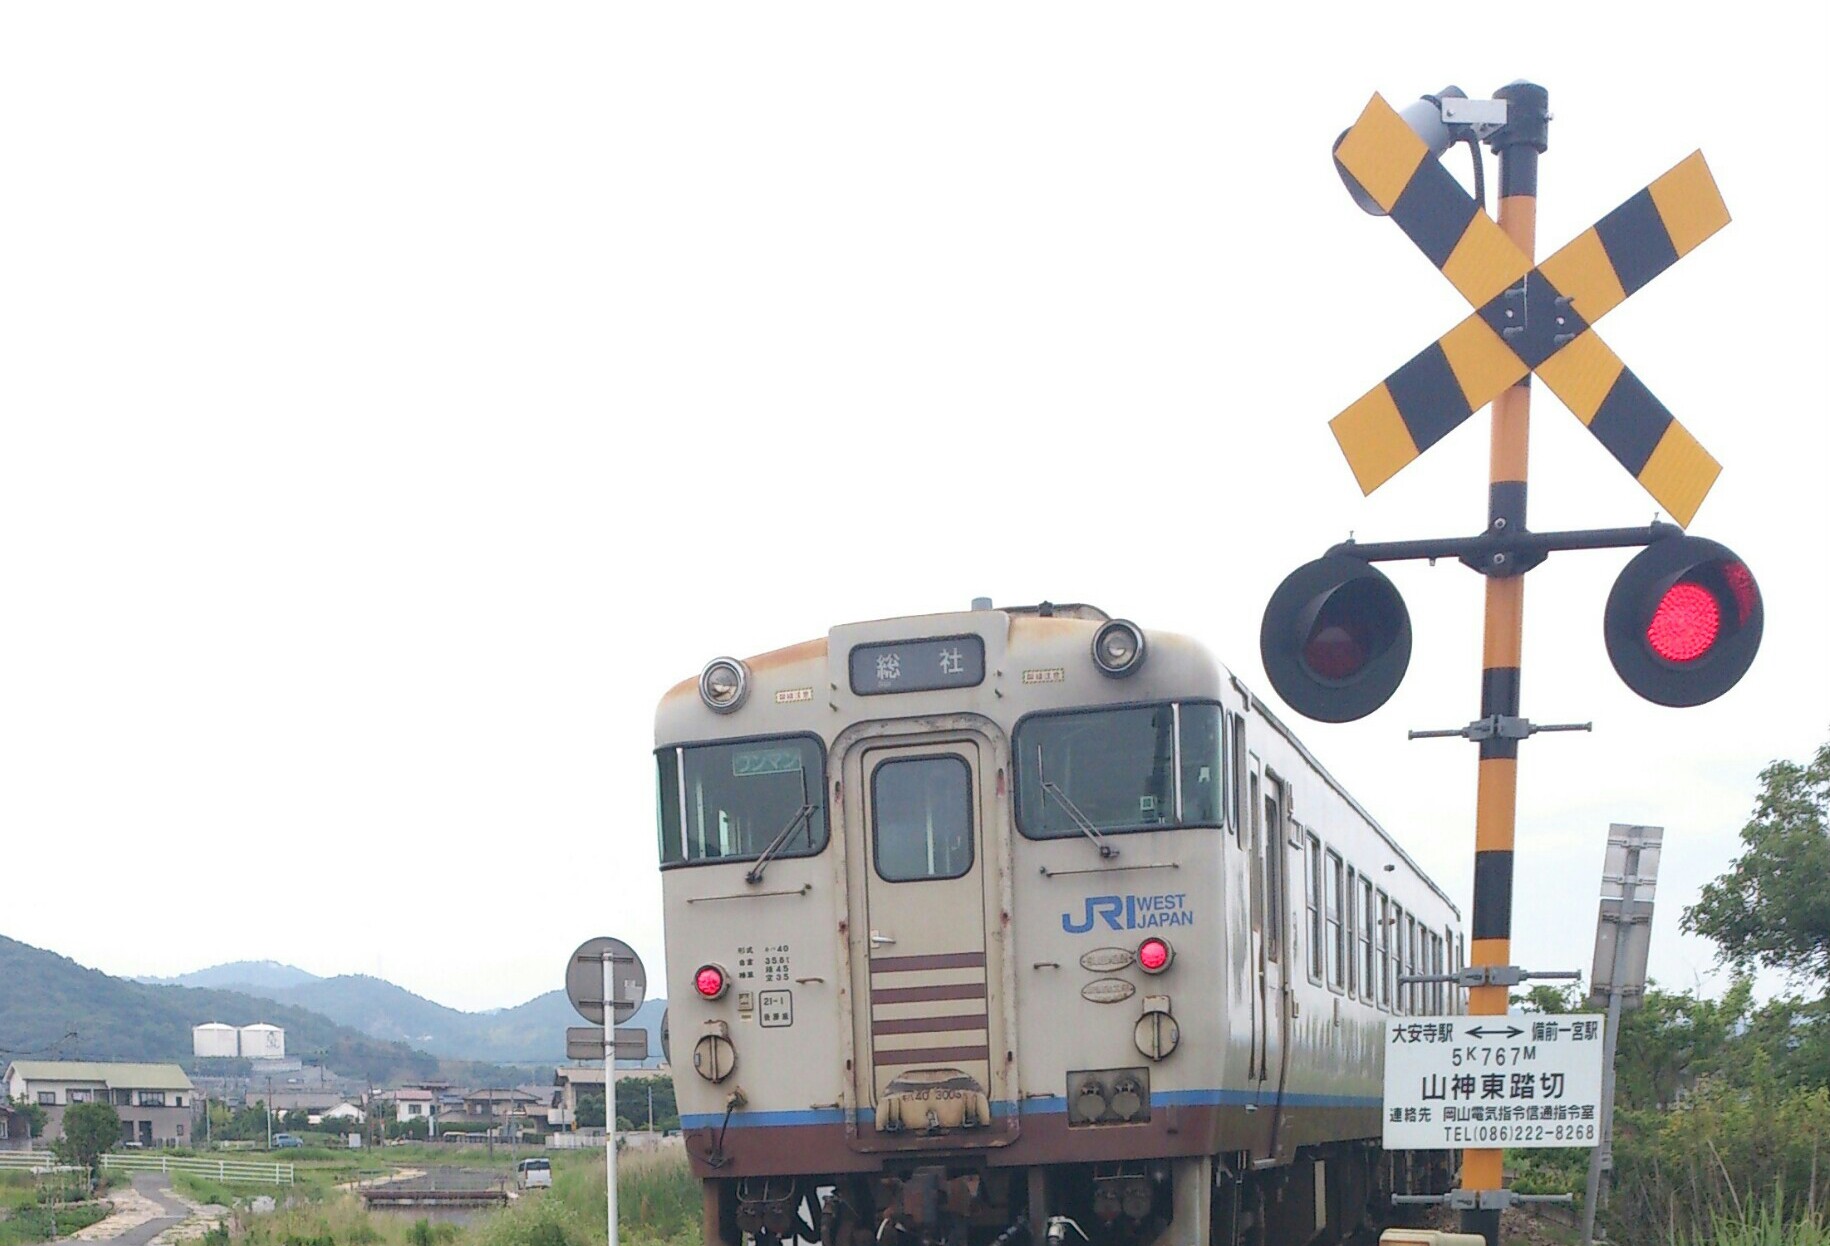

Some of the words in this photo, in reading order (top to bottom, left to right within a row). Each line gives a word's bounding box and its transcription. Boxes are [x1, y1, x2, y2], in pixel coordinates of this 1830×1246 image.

[876, 647, 964, 680] 総社
[1062, 895, 1124, 933] JR
[1137, 894, 1186, 911] WEST
[1137, 911, 1193, 929] JAPAN
[1392, 1023, 1453, 1043] 大安寺駅
[1531, 1021, 1598, 1042] 備前一宮駅
[1421, 1072, 1564, 1101] 山神東踏切
[1389, 1107, 1432, 1123] 連絡先
[1443, 1105, 1595, 1122] 岡山電気指令信通指令室
[1445, 1124, 1594, 1142] TEL(086)222-8268
